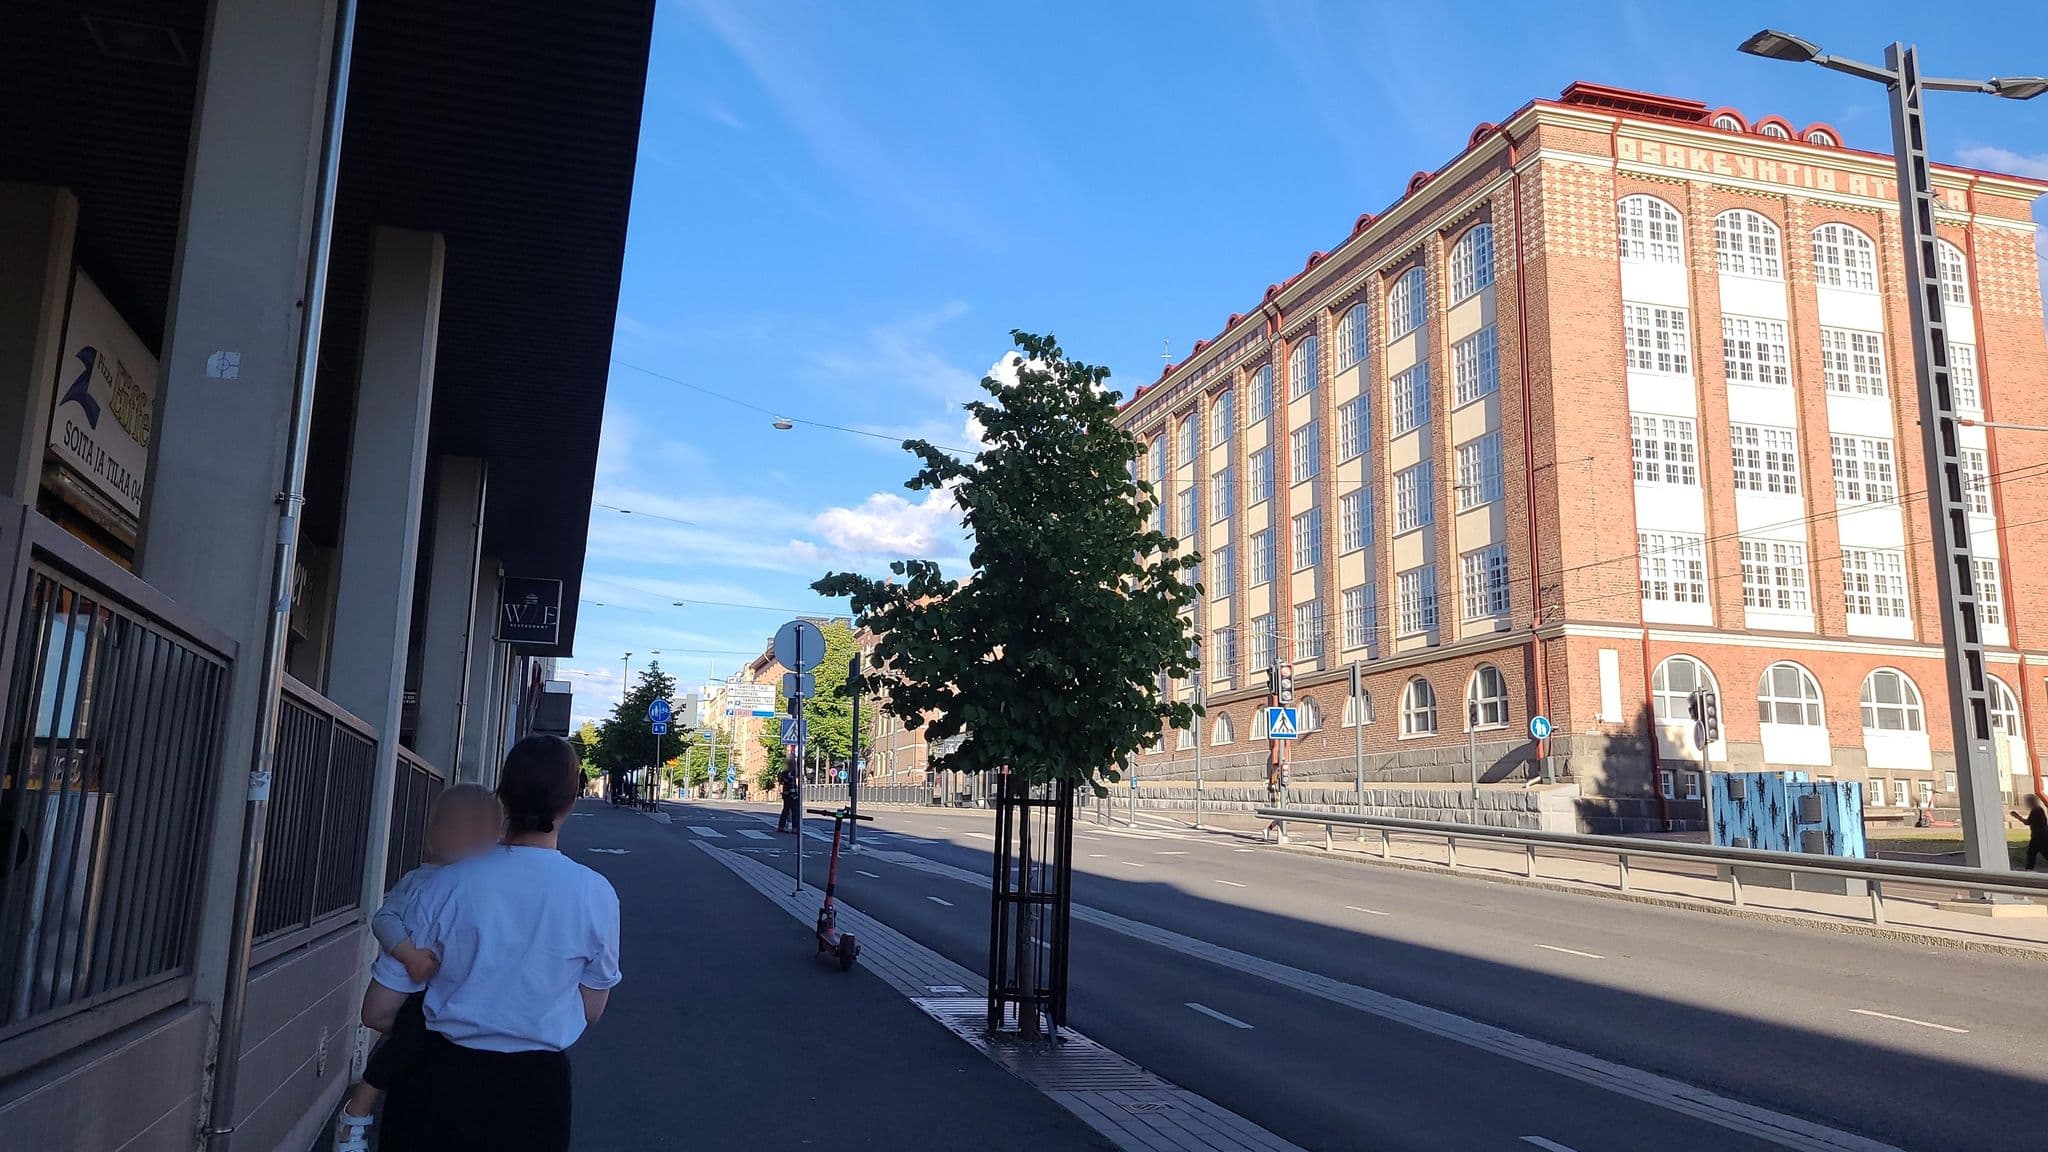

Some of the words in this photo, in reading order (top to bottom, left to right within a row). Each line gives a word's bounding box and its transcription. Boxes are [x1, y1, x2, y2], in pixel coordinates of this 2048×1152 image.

[97, 352, 113, 387] Pizza
[109, 359, 152, 447] Eiffe
[63, 420, 93, 466] SOITA
[94, 446, 104, 475] JA
[106, 457, 131, 497] TILAA
